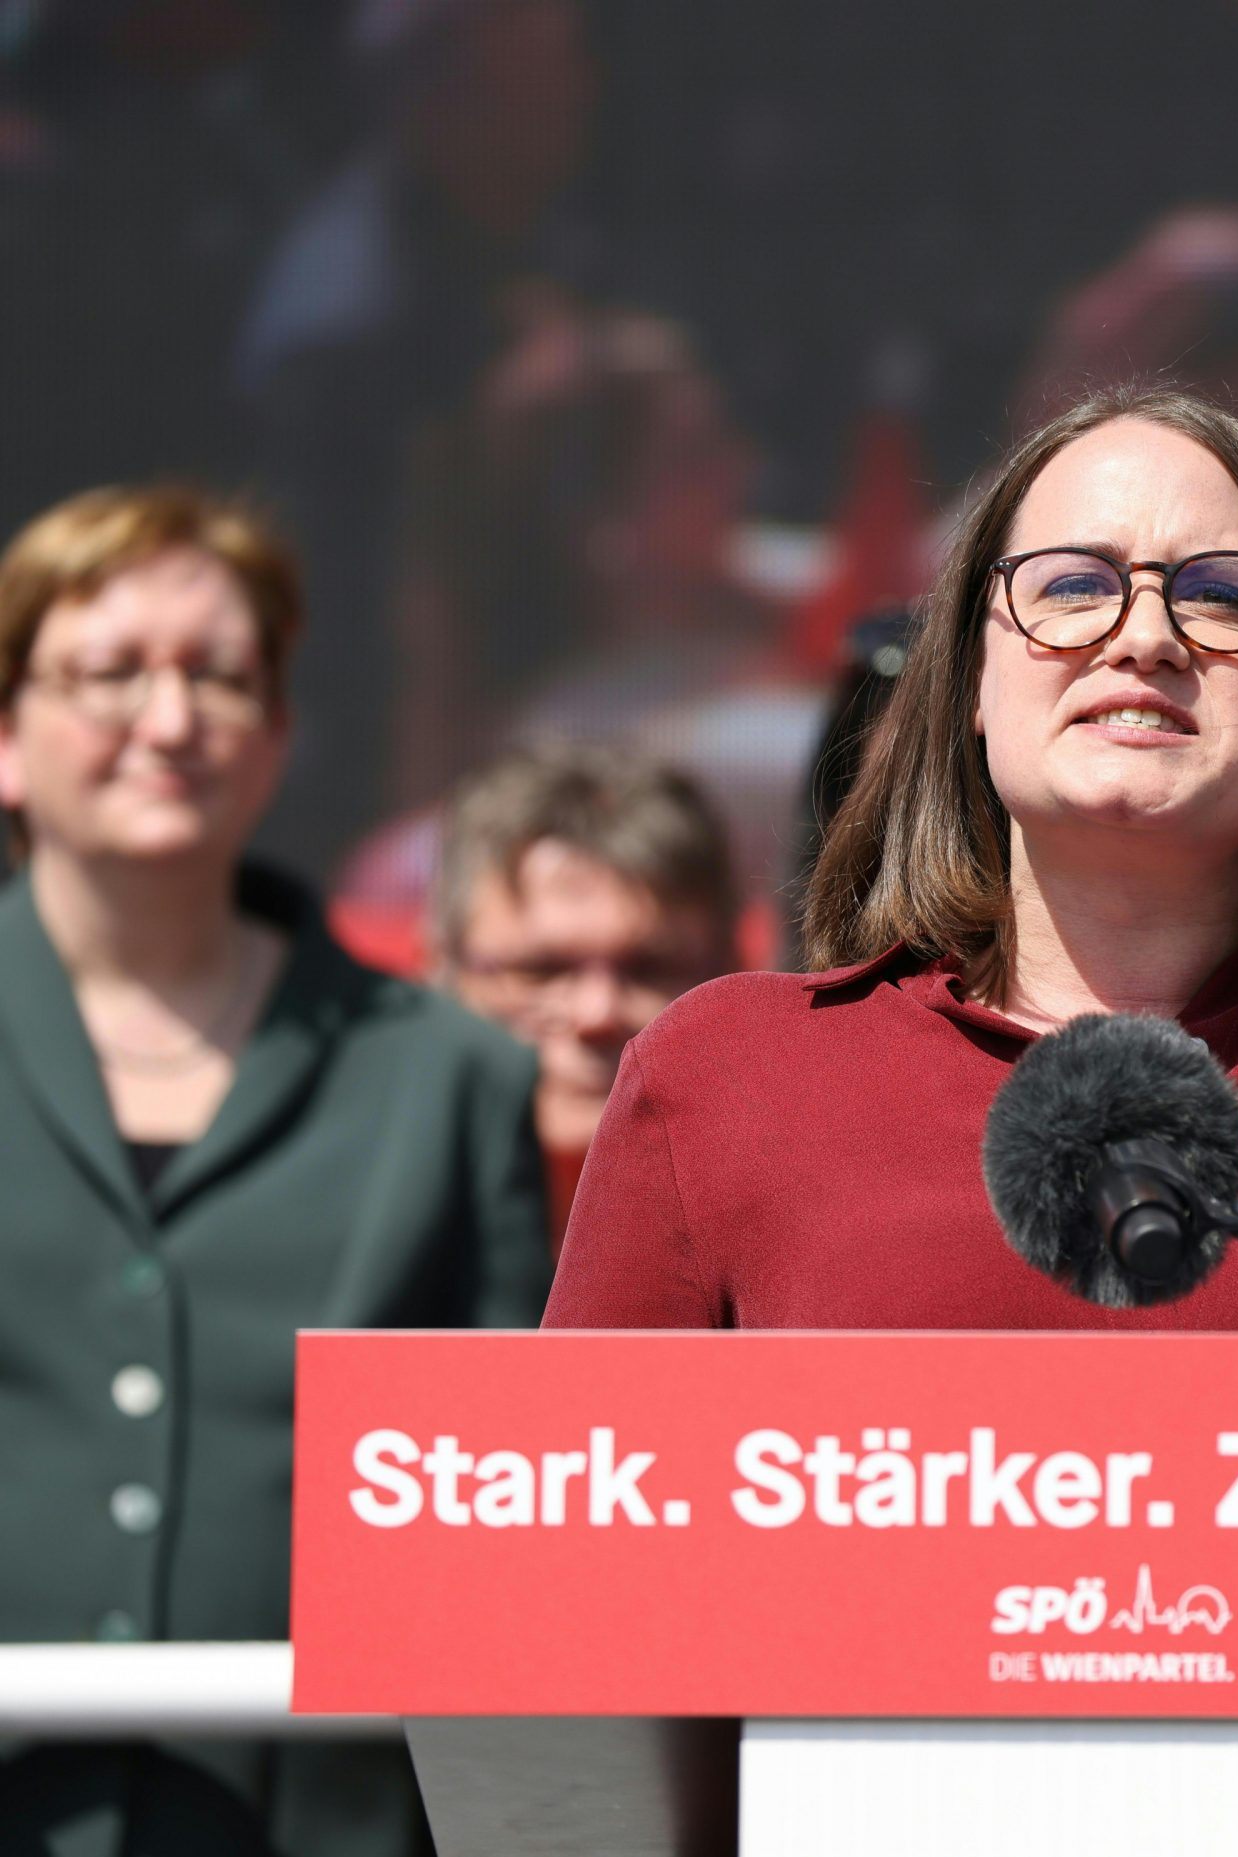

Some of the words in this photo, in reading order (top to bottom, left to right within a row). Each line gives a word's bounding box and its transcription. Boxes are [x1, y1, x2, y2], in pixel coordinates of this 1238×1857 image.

[348, 1426, 692, 1529] Stark.
[730, 1426, 1175, 1530] Stärker.
[989, 1576, 1108, 1635] SPÖ
[989, 1652, 1037, 1682] DIE
[1041, 1652, 1235, 1683] WIENPARTEI.
